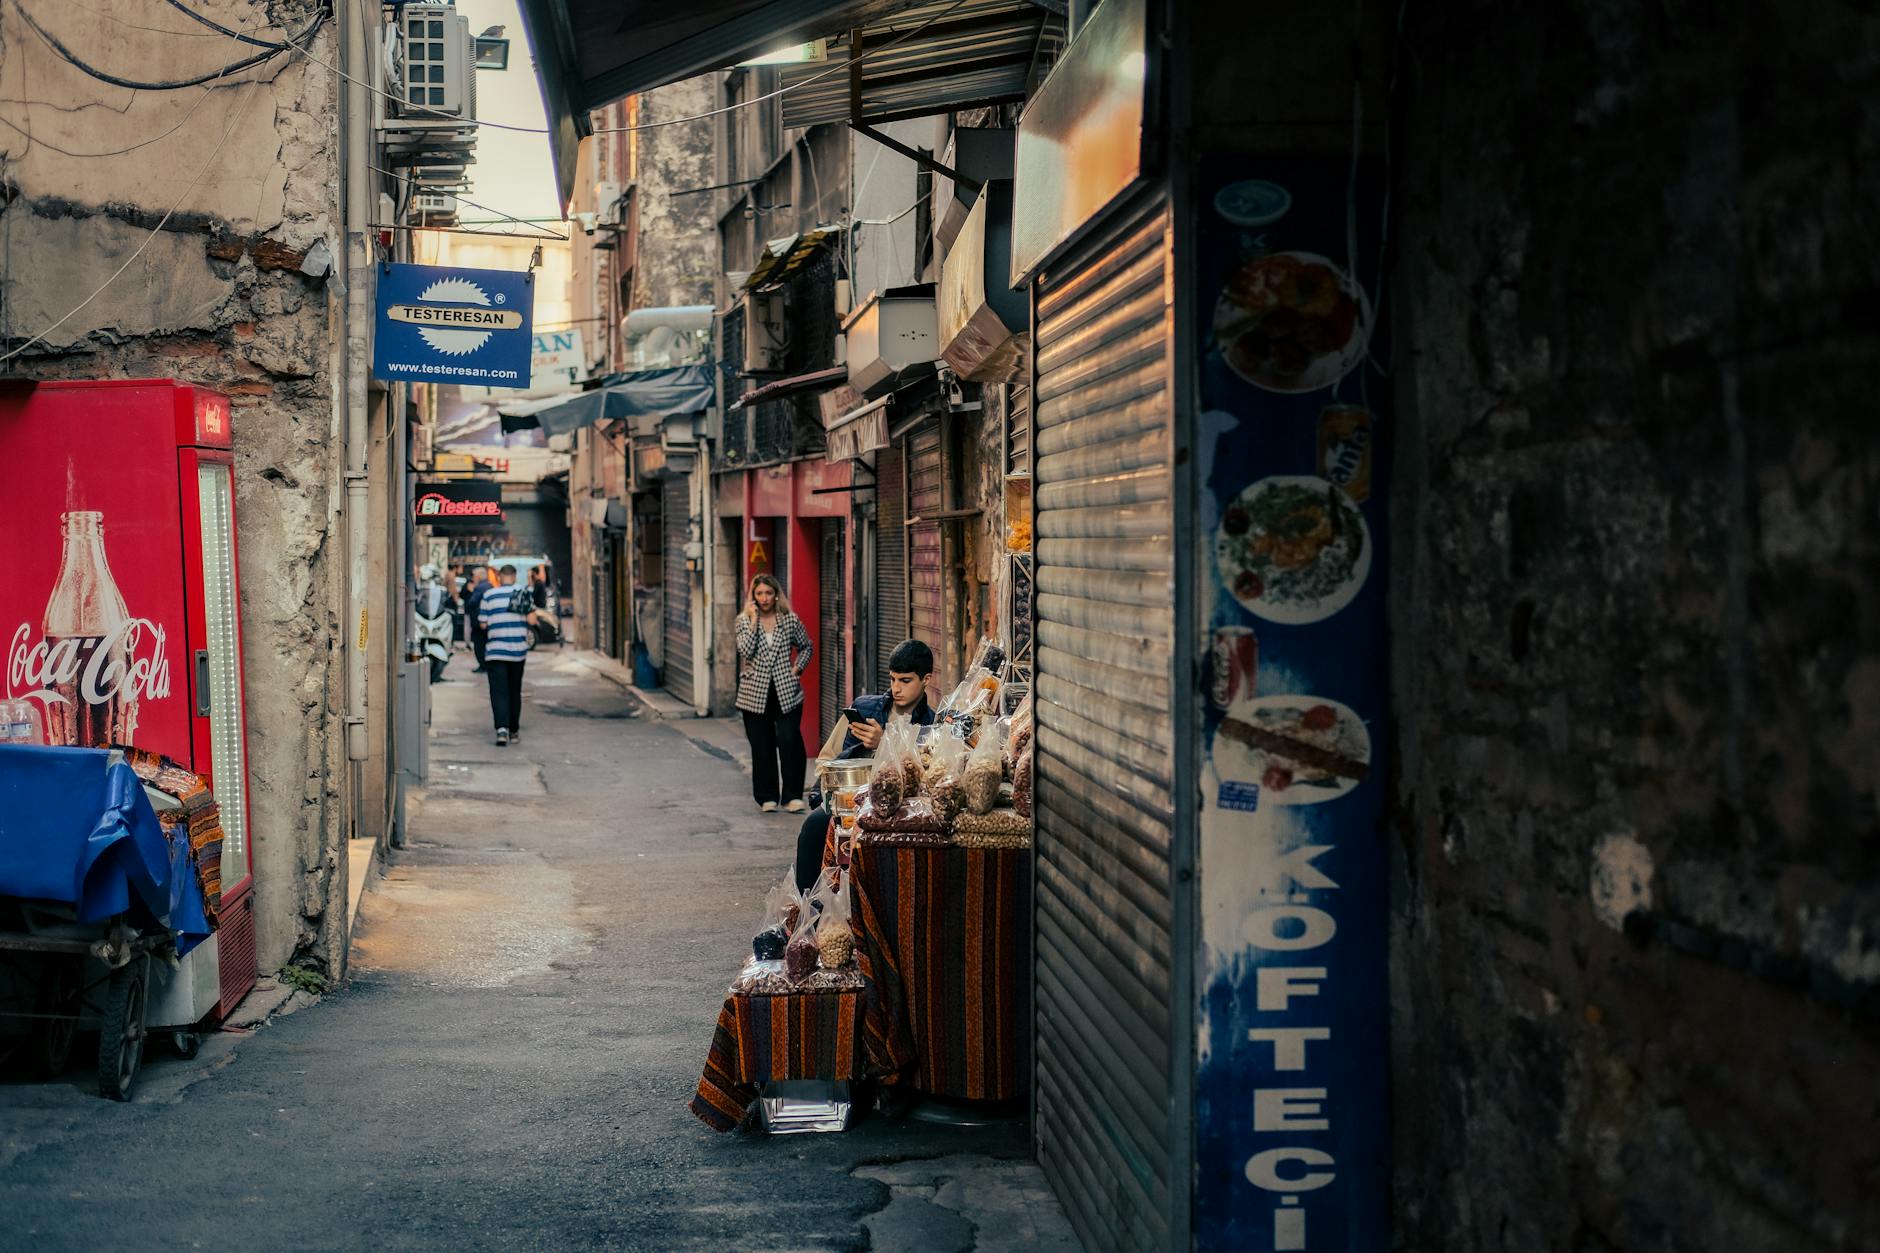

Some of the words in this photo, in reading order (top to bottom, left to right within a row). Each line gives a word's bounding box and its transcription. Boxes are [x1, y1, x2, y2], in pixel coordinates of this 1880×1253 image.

[403, 308, 504, 324] TESTERESAN
[388, 363, 517, 379] www.testeresan.com
[7, 618, 171, 705] Coca-Cola
